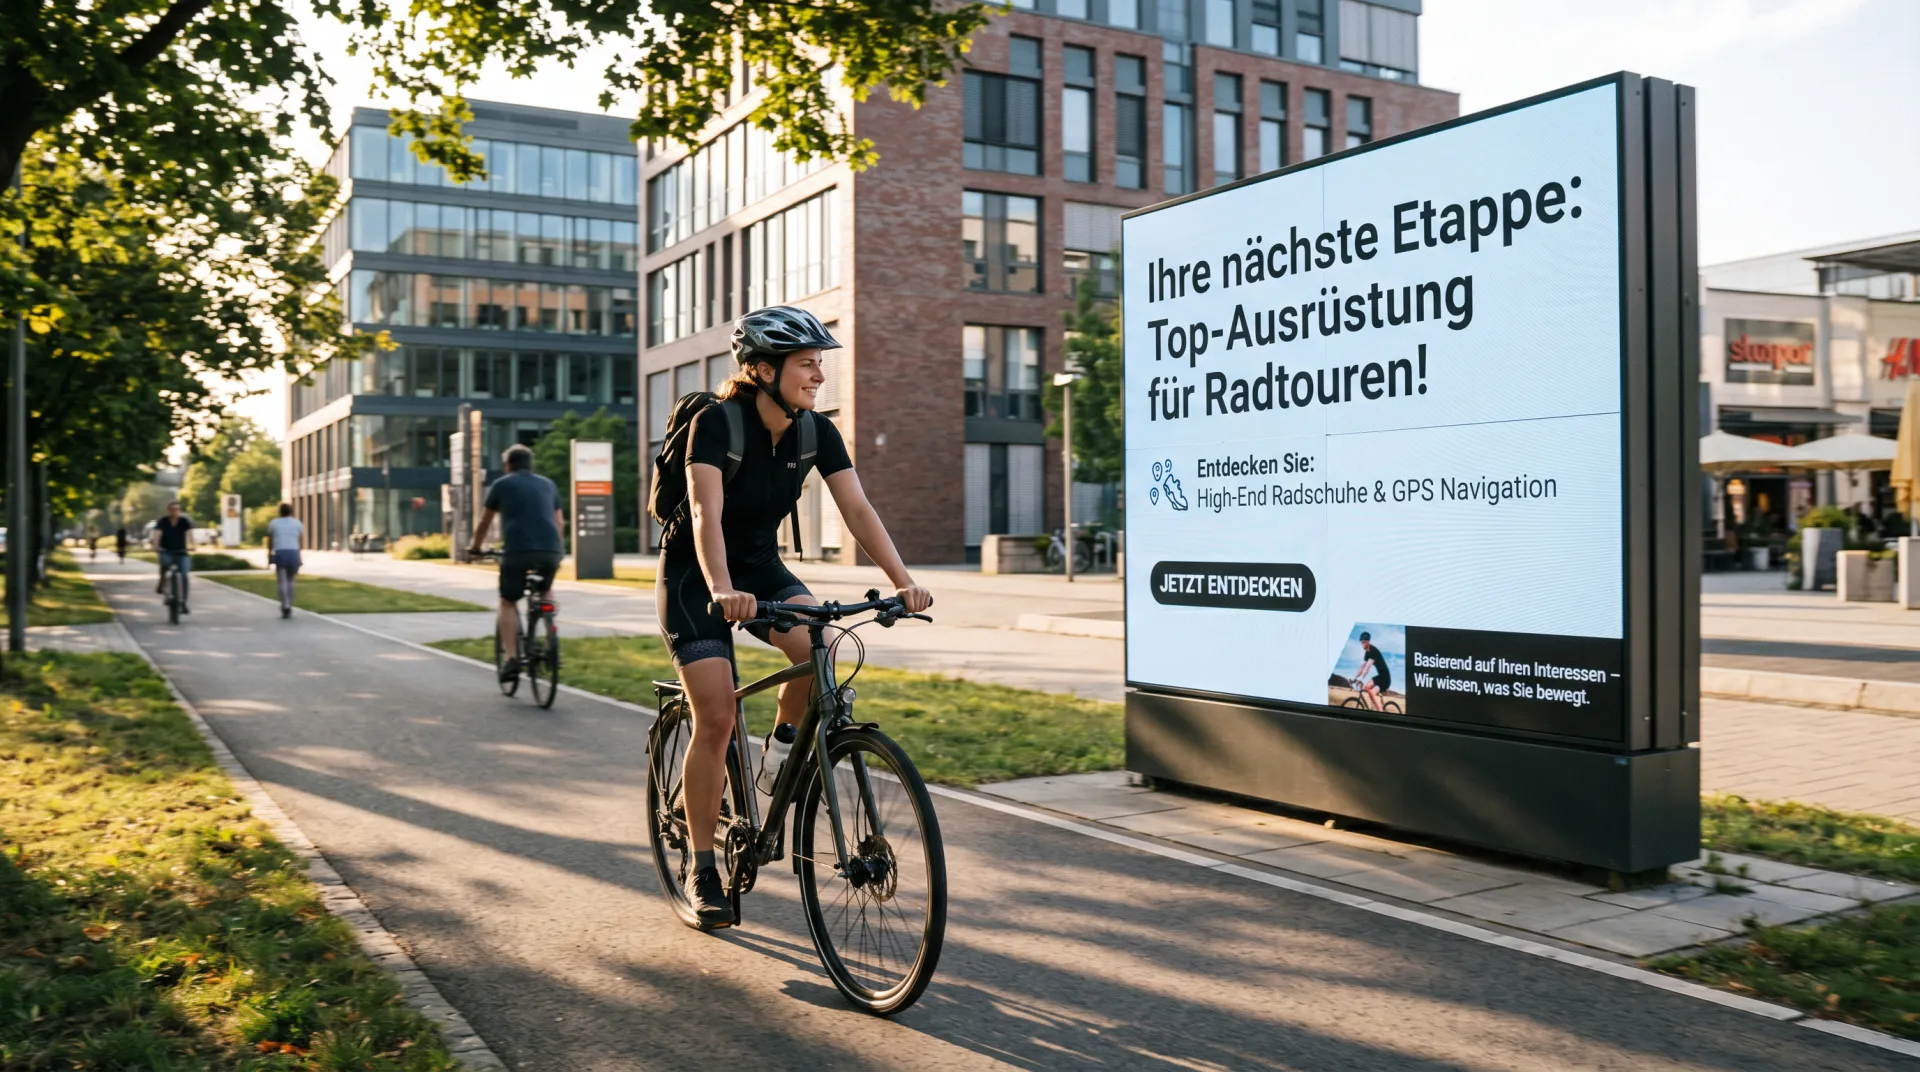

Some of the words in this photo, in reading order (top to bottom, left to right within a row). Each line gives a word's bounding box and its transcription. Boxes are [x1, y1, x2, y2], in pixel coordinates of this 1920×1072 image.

[1148, 257, 1211, 304] Ihre
[1222, 219, 1379, 289] nächste
[1393, 175, 1583, 255] Etappe:
[1147, 274, 1474, 369] Top-Ausrüstung
[1147, 375, 1195, 422] für
[1205, 343, 1428, 417] Radtouren!
[1197, 454, 1278, 479] Entdecken
[1283, 451, 1315, 474] Sie:
[1197, 484, 1267, 514] High-End
[1272, 480, 1368, 506] Radschuhe
[1373, 479, 1387, 503] &
[1392, 477, 1434, 503] GPS
[1441, 473, 1557, 506] Navigation
[1159, 573, 1205, 594] JETZT
[1207, 574, 1303, 599] ENTDECKEN
[1414, 651, 1473, 671] Basierend
[1474, 657, 1497, 673] auf
[1498, 658, 1531, 676] Ihren
[1534, 661, 1607, 683] Interessen
[1413, 672, 1435, 689] Wir
[1435, 676, 1482, 696] wissen,
[1483, 682, 1510, 696] was
[1512, 681, 1534, 699] Sie
[1536, 683, 1591, 708] bewegt.
